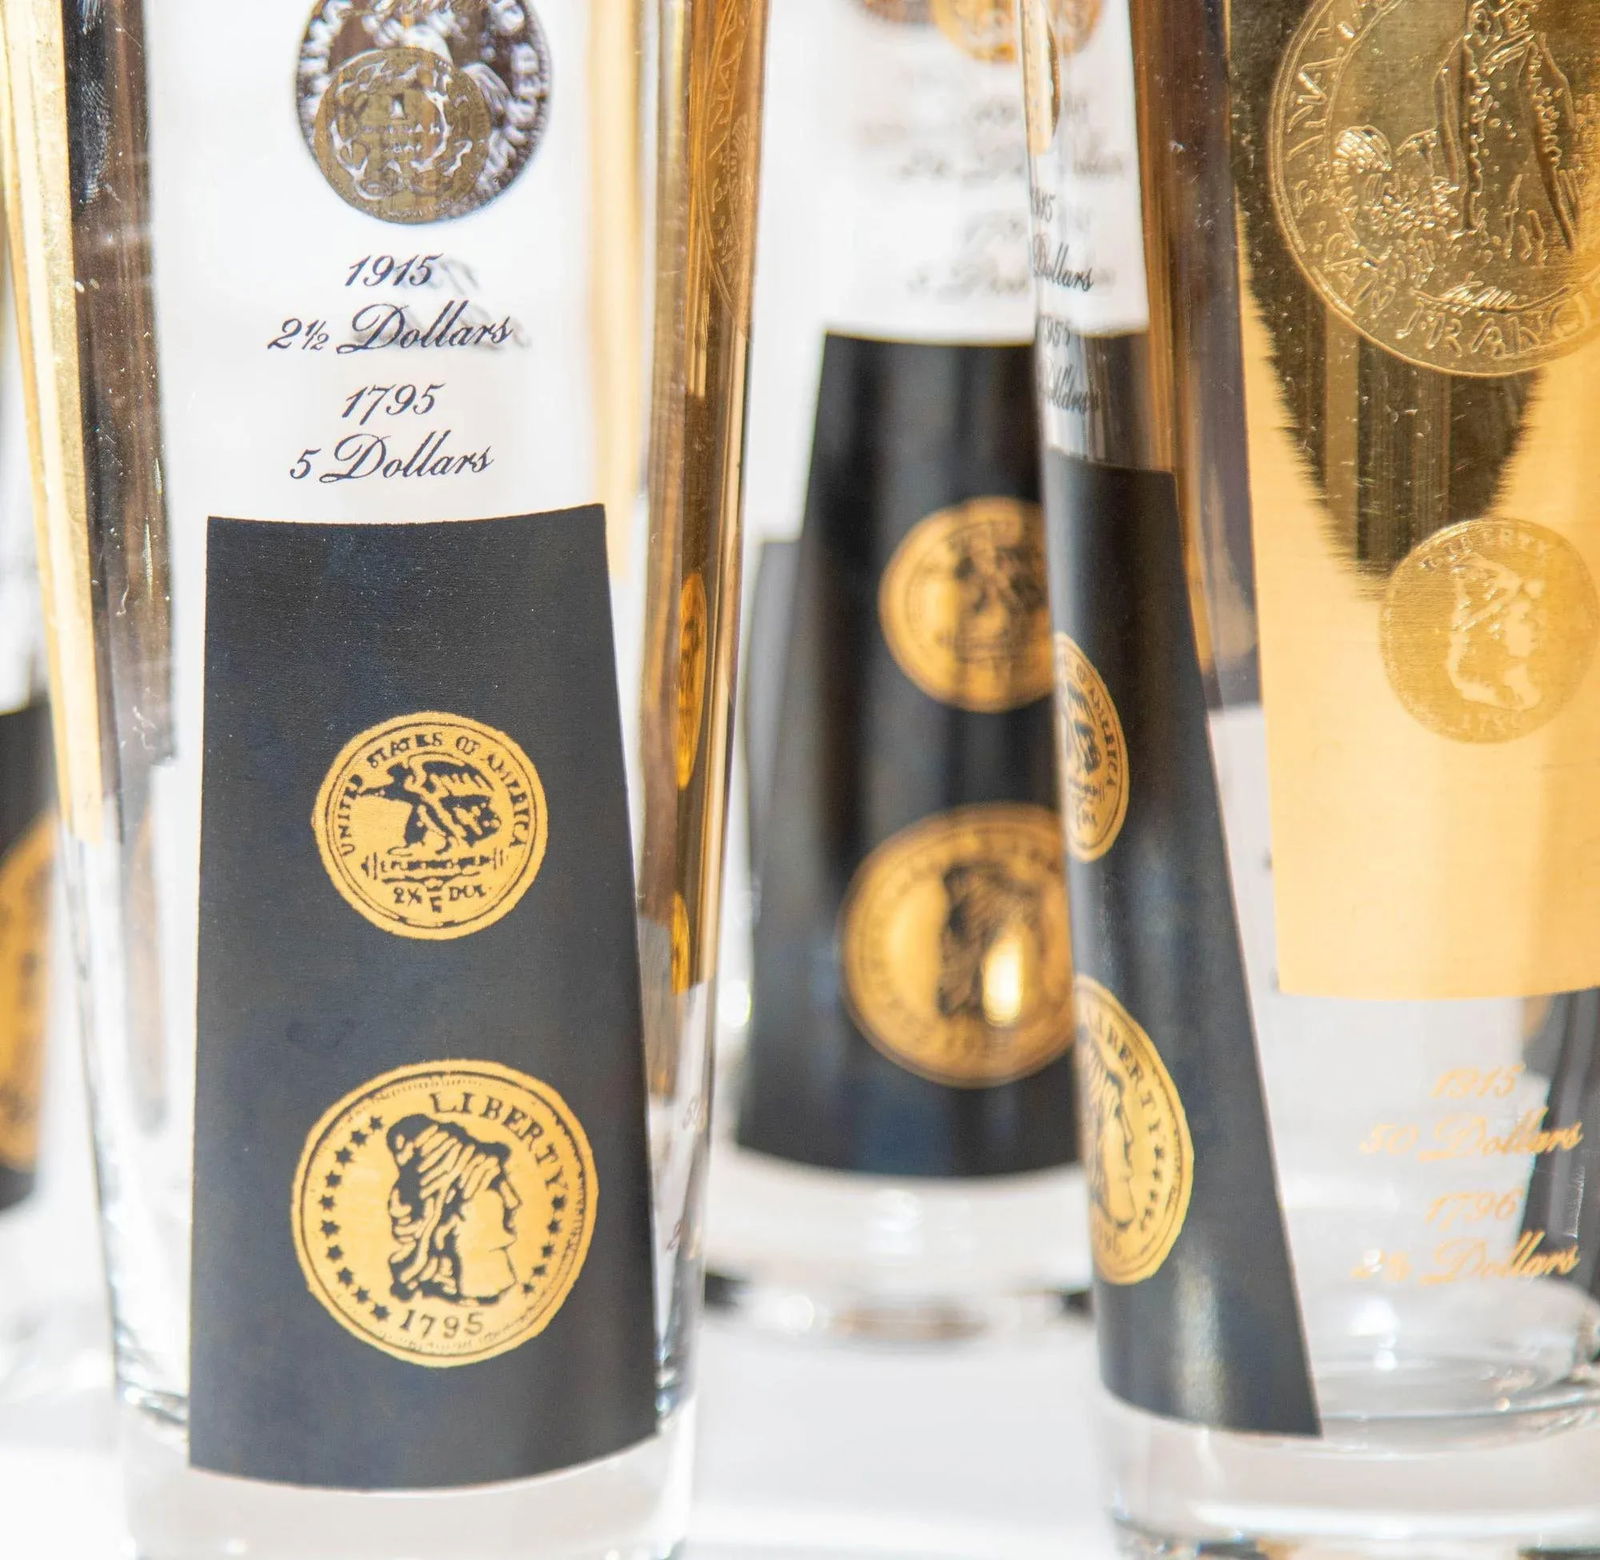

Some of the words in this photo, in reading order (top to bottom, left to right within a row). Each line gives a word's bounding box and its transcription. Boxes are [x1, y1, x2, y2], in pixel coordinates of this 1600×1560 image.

[344, 253, 444, 287] 1915
[267, 317, 330, 351] 2½
[336, 299, 514, 354] Dollars
[342, 381, 447, 425] 1795
[289, 447, 321, 480] 5
[318, 428, 495, 483] Dollars
[366, 731, 444, 769] STATES
[429, 1090, 568, 1193] LIBERTY
[1359, 1121, 1420, 1156] 50
[1417, 1105, 1584, 1164] Dollars
[1416, 1229, 1581, 1288] Dollars
[400, 1308, 488, 1340] 1795
